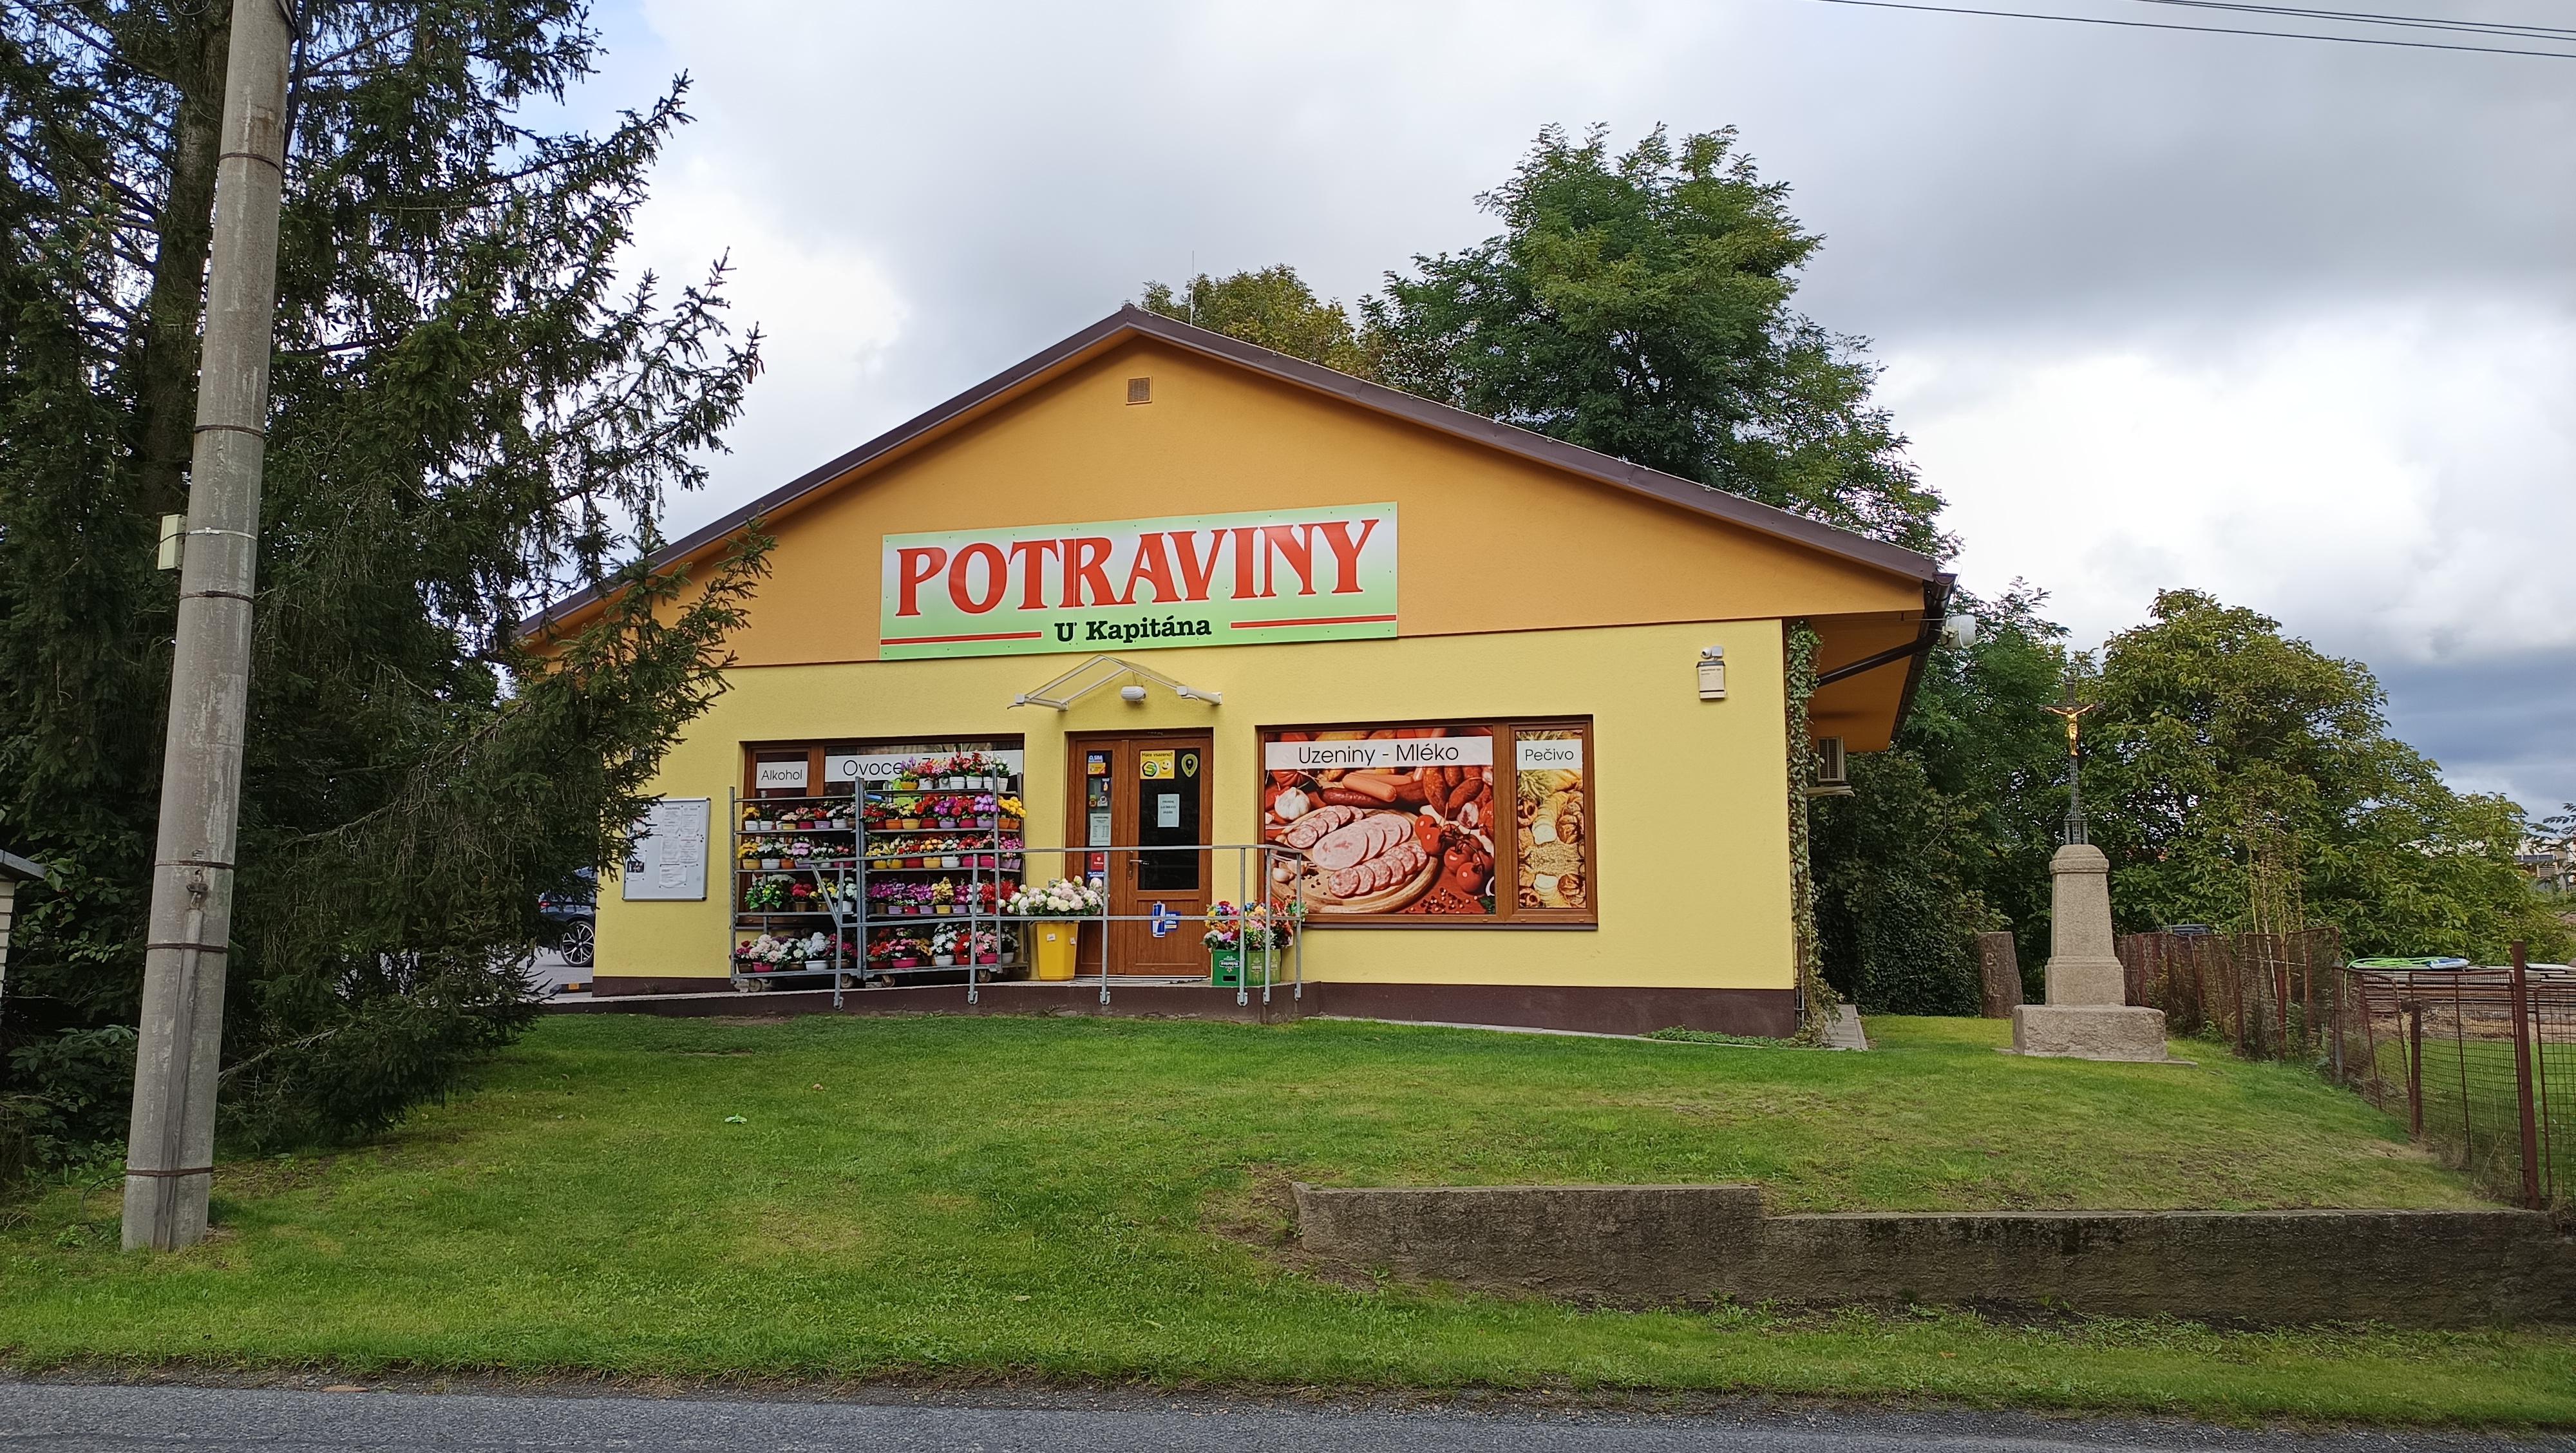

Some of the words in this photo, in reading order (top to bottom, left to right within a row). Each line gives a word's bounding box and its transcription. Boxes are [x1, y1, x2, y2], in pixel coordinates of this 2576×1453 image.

[895, 519, 1379, 616] POTRAVINY
[1054, 622, 1075, 642] U
[1086, 615, 1212, 643] Kapitána
[1299, 746, 1376, 766] Uzeniny
[1396, 744, 1459, 762] Mléko
[1525, 748, 1574, 761] Pečivo
[761, 769, 802, 780] Alkohol
[843, 760, 902, 775] Ovoce
